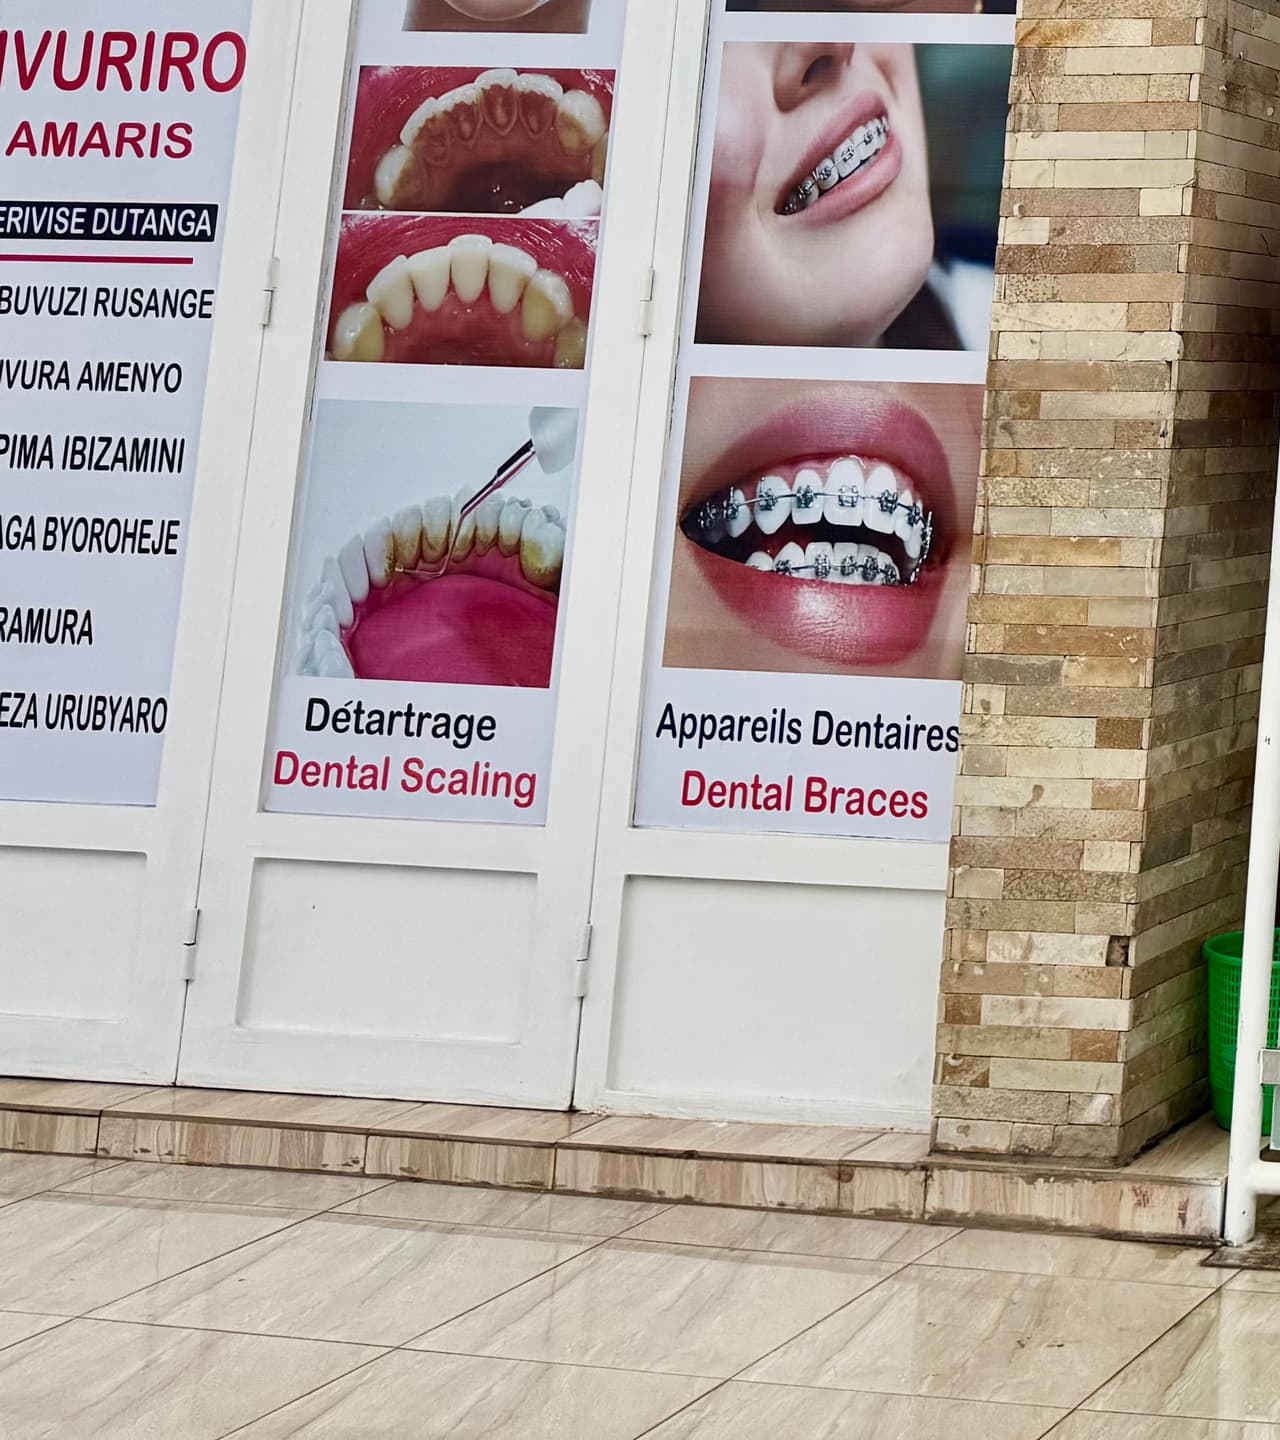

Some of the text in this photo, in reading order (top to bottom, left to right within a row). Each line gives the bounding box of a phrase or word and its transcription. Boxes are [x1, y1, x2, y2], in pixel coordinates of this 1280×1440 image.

[5, 121, 193, 159] AMARIS
[92, 208, 212, 237] DUTANGA
[93, 287, 215, 319] RUSANGE
[0, 360, 183, 394] VURA AMENYO
[61, 435, 186, 474] IBIZAMINI
[42, 516, 181, 555] BYOROHEJE
[45, 693, 169, 734] URUBYARO
[304, 697, 497, 749] Détartrage
[656, 702, 960, 752] Appareils Dentaires
[273, 750, 536, 807] Dental Scaling
[681, 770, 929, 819] Dental Braces
